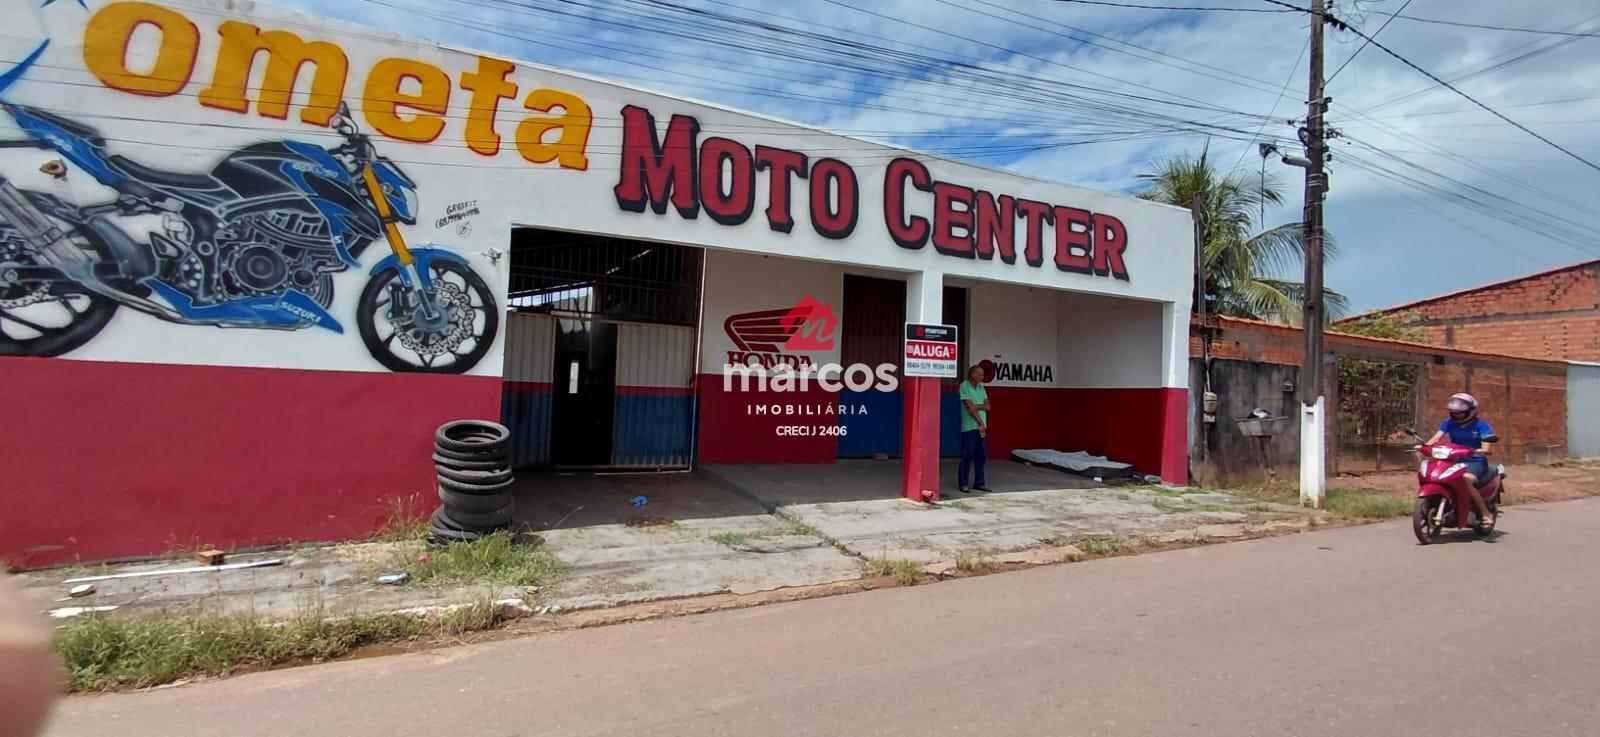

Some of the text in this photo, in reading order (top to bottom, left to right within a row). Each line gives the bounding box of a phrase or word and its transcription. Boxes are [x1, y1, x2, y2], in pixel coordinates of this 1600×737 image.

[614, 104, 1130, 281] MOTO CENTER
[280, 301, 322, 323] SUZUKI
[913, 344, 951, 358] ALUGA
[993, 362, 1054, 382] YAMAHA
